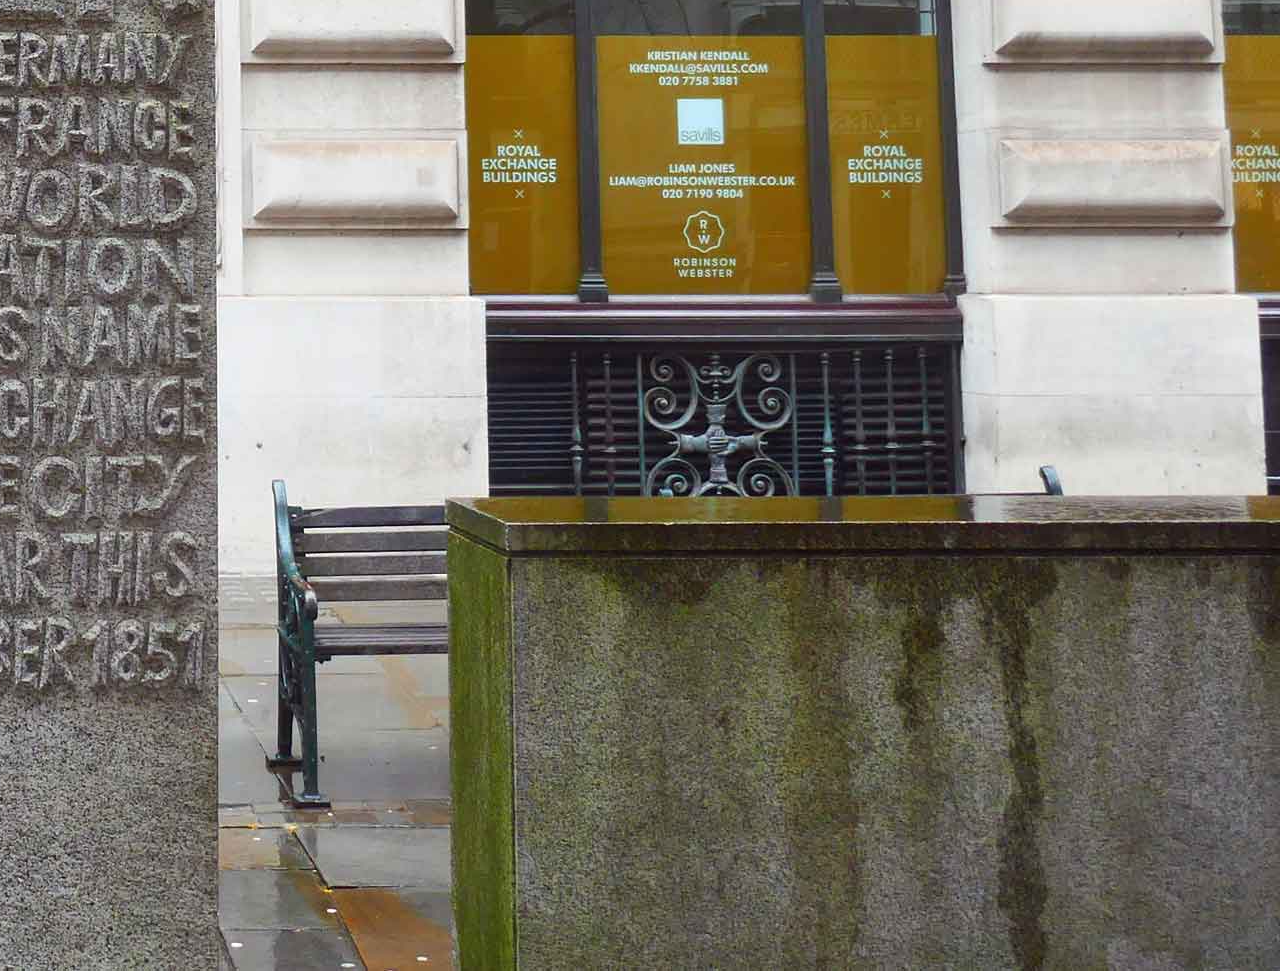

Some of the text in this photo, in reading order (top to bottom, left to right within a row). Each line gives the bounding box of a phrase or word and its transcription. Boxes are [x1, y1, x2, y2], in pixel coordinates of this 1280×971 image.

[647, 51, 751, 61] KRISTIAN KENDALL
[629, 63, 769, 74] KKENDALL@SAVILLS.COM
[658, 76, 679, 87] 020
[682, 76, 710, 87] 7758
[680, 126, 721, 143] savills
[496, 145, 541, 157] ROYAL
[863, 145, 907, 157] ROYAL
[1235, 145, 1280, 157] ROYAL
[481, 158, 558, 170] EXCHANGE
[669, 164, 735, 174] LIAM JONES
[847, 158, 924, 170] EXCHANGE
[482, 171, 558, 183] BUILDINGS
[609, 176, 795, 187] LIAM@ROBINSONWEBSTER.CO.UK
[848, 171, 924, 183] BUILDINGS
[662, 189, 683, 199] 020
[686, 188, 713, 199] 7190
[673, 257, 737, 267] ROBINSON
[678, 268, 734, 278] WEBSTER
[39, 303, 204, 372] NAME
[28, 454, 198, 520] CITY
[58, 531, 198, 608] THIS
